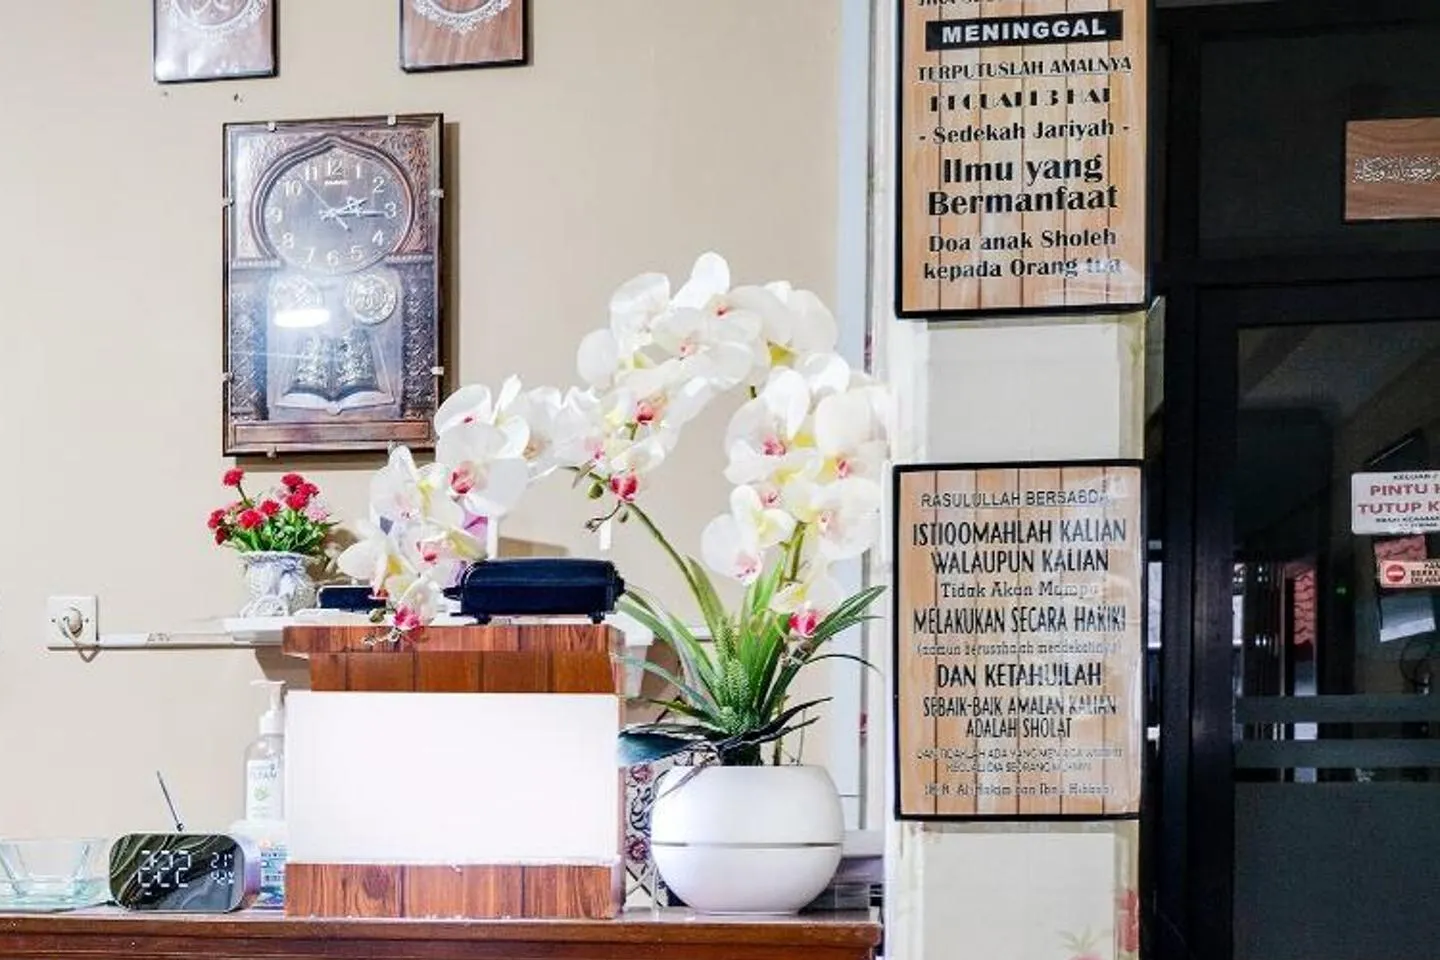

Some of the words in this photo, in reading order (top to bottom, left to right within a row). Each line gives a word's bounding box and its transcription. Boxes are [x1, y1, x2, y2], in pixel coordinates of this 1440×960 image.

[941, 18, 1108, 44] MENINGGAL
[917, 62, 1044, 81] TERPUTUSLAH
[1049, 56, 1132, 75] AMALNYA
[932, 122, 1026, 145] Sedekah
[1032, 119, 1115, 141] Jariyah
[327, 159, 343, 176] 12
[943, 158, 1013, 183] Ilmu
[1025, 154, 1103, 187] yang
[372, 176, 385, 193] 2
[384, 201, 397, 219] 3
[927, 185, 1119, 217] Bermanfaat
[371, 230, 384, 246] 4
[928, 234, 972, 253] Doa
[979, 230, 1034, 250] anak
[1040, 228, 1117, 250] Sholeh
[923, 261, 1002, 281] kepada
[1009, 258, 1079, 277] Orang
[920, 490, 1021, 508] RASULULLAH
[1370, 483, 1428, 496] PINTU
[1357, 501, 1423, 515] TUTUP
[1059, 518, 1127, 542] KALIAN
[930, 550, 1035, 574] WALAUPUN
[1041, 548, 1109, 572] KALIAN
[940, 582, 987, 598] Tidak
[990, 581, 1033, 597] Akan
[913, 606, 1006, 634] MELAKUKAN
[1010, 605, 1069, 633] SECARA
[936, 663, 977, 688] DAN
[922, 696, 1003, 717] SEBAIK-BAIK
[1007, 695, 1064, 715] AMALAN
[965, 717, 1018, 738] ADALAH
[1022, 717, 1073, 738] SHOLAT
